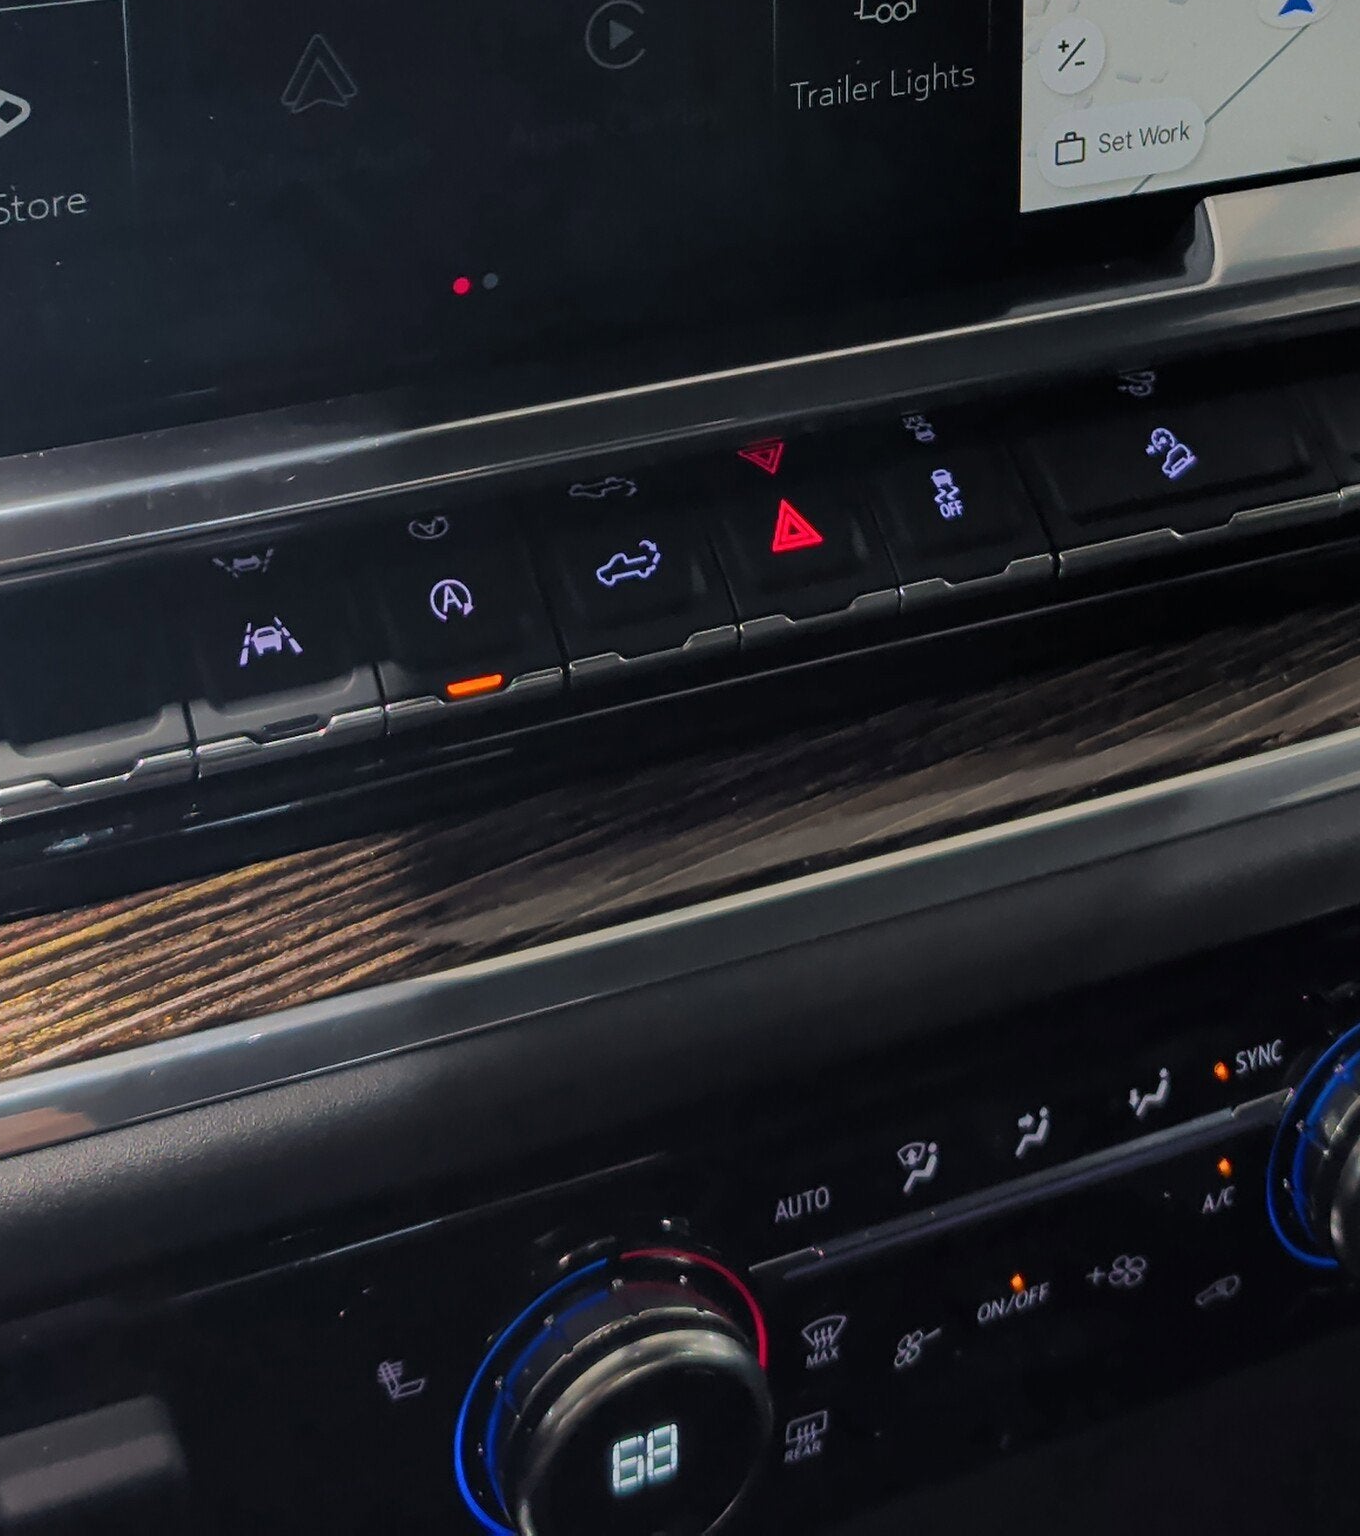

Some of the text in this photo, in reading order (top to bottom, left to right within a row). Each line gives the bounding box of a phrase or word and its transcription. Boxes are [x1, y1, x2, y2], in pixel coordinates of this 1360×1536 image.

[790, 63, 974, 109] Trailer Lights
[1099, 121, 1189, 153] Set Work
[940, 500, 963, 518] OFF
[1235, 1039, 1283, 1074] SYNC
[775, 1186, 830, 1223] AUTO
[1202, 1185, 1235, 1215] A/C
[977, 1282, 1050, 1323] ON/OFF
[806, 1346, 839, 1368] MAX
[613, 1424, 677, 1492] 68
[784, 1439, 822, 1462] REAR
